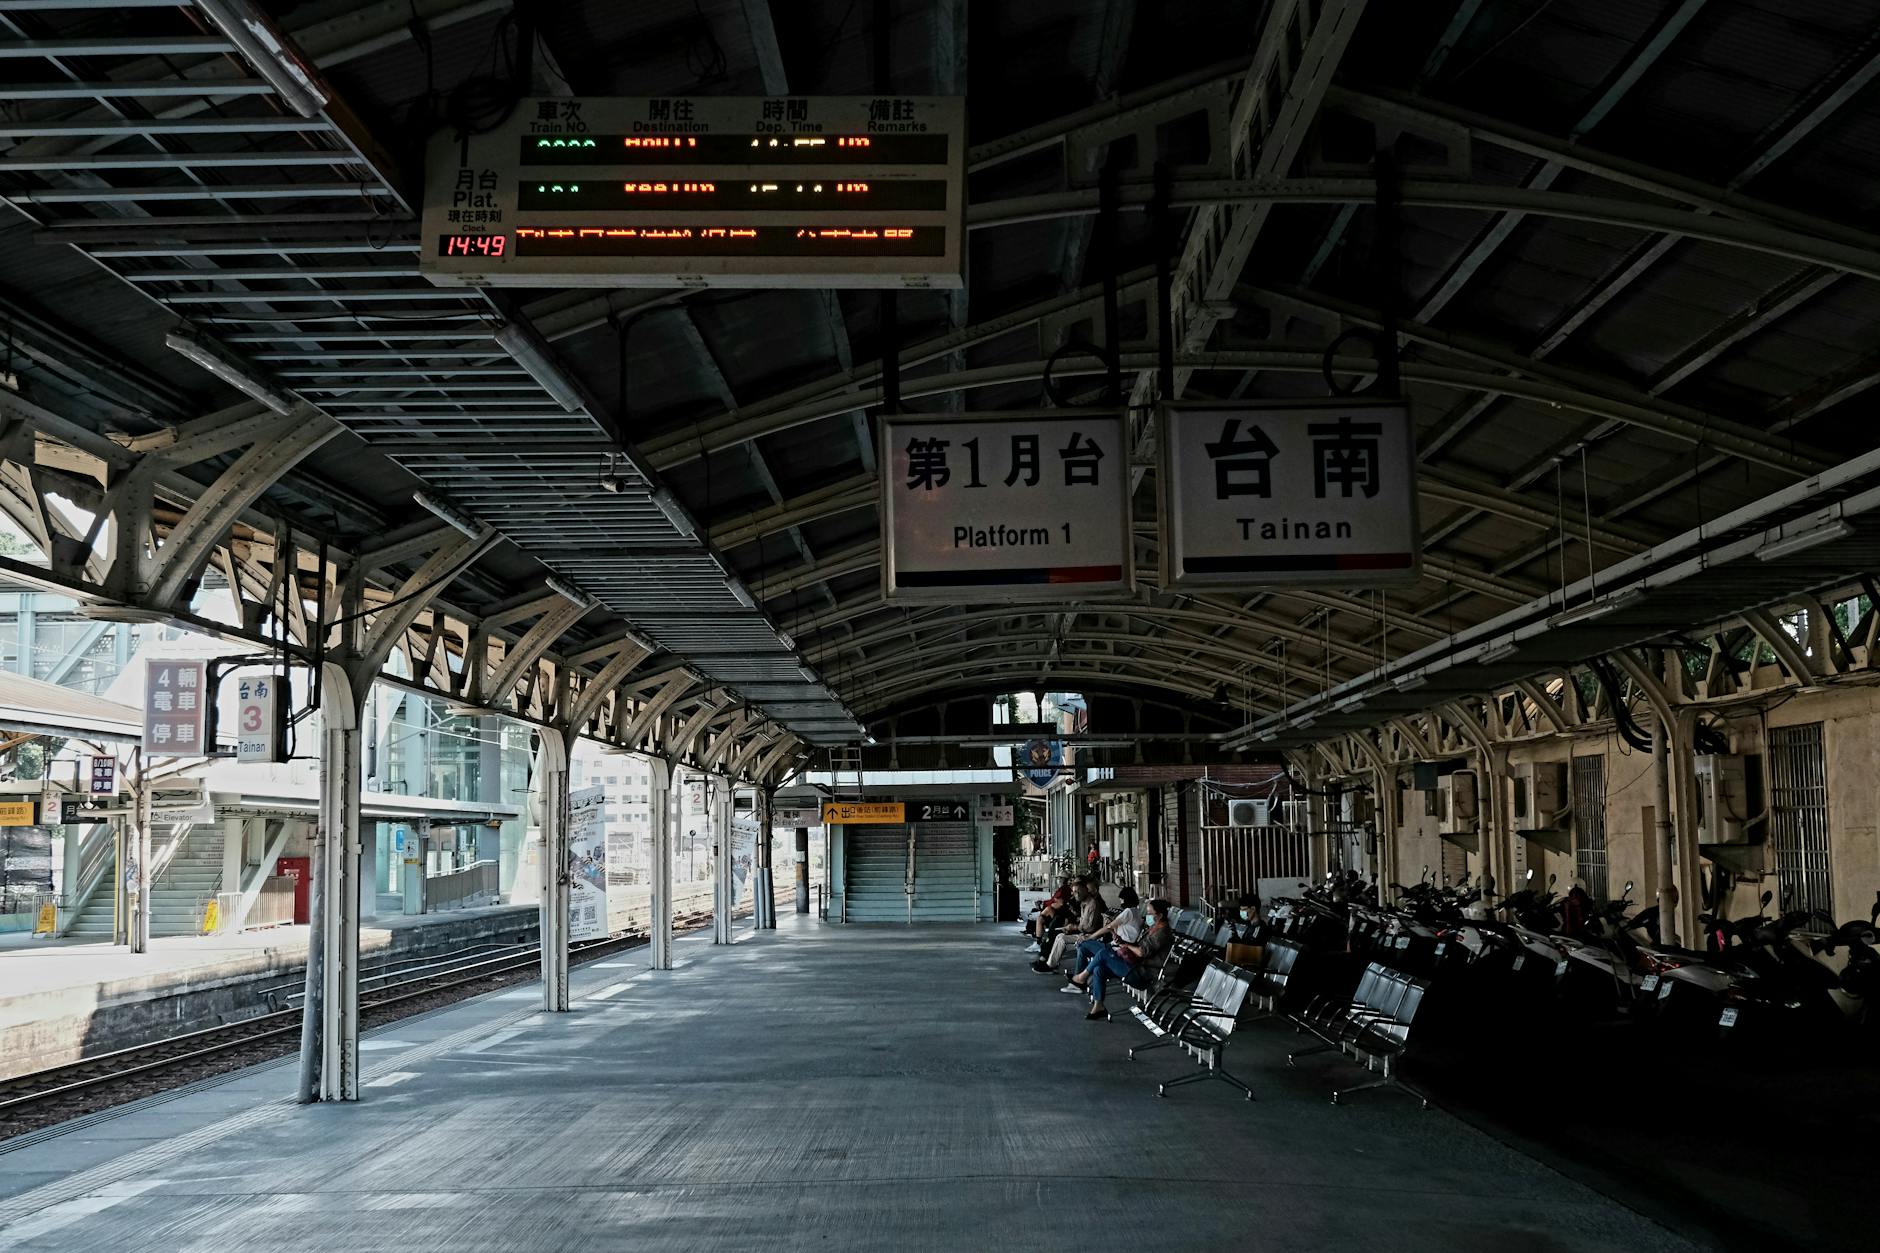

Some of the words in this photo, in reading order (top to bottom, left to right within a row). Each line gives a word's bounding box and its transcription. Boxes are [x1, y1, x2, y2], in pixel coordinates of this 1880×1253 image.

[538, 100, 581, 121] 車次
[648, 99, 696, 121] 開往
[762, 99, 808, 121] 時間
[869, 99, 915, 121] 備註
[530, 122, 562, 133] Train
[567, 122, 592, 133] NO.
[633, 122, 710, 134] Destination
[756, 122, 786, 135] Dep.
[792, 122, 823, 133] Time
[868, 121, 927, 132] Remarks
[455, 170, 499, 191] 月台
[453, 192, 498, 208] Plat.
[448, 209, 503, 223] 現在時刻
[462, 225, 486, 234] Clock
[447, 235, 506, 256] 14:49
[905, 432, 1105, 491] 第1月台
[1205, 417, 1382, 500] 台南
[954, 524, 1049, 548] Platform
[1061, 522, 1071, 545] 1
[1236, 518, 1353, 541] Tainan
[239, 681, 269, 700] 台南
[153, 691, 197, 711] 電車
[243, 705, 263, 731] 3
[152, 723, 196, 744] 停車
[238, 741, 266, 753] Tainan
[1030, 769, 1053, 778] POLICE
[47, 801, 57, 812] 2
[693, 793, 701, 804] 2
[164, 814, 192, 822] Elevator
